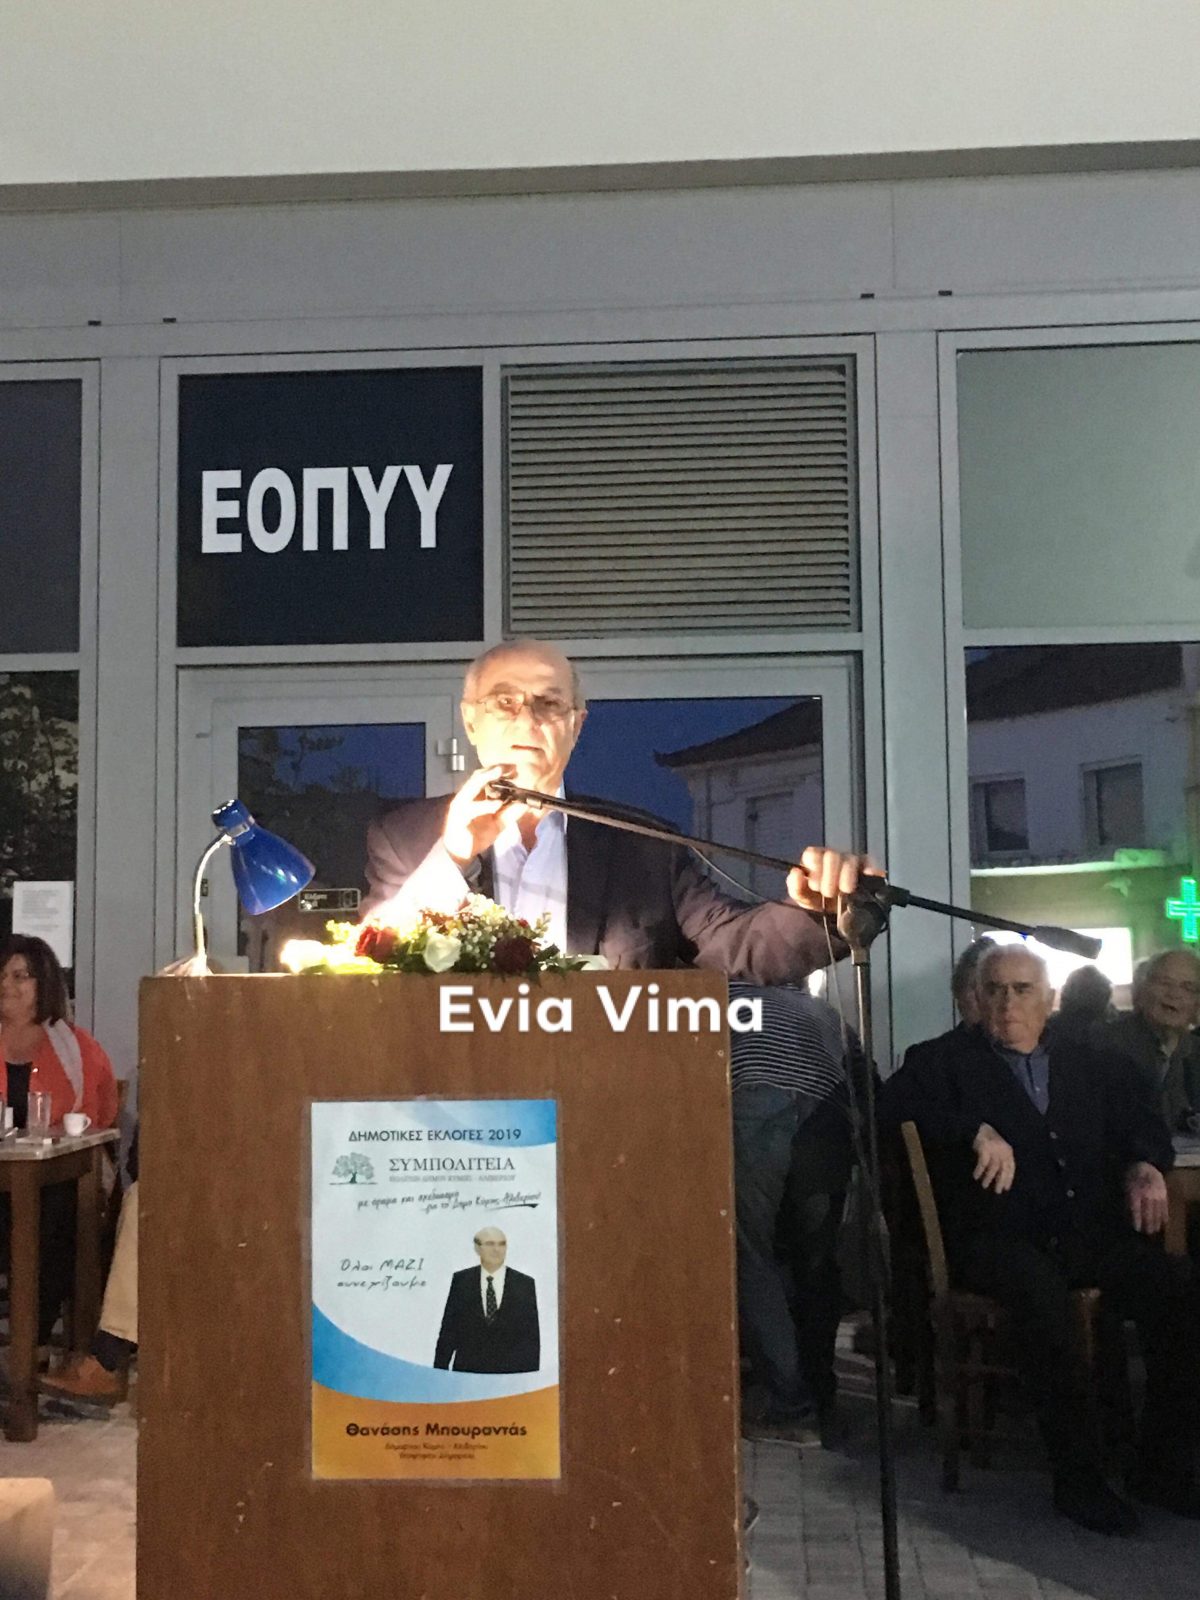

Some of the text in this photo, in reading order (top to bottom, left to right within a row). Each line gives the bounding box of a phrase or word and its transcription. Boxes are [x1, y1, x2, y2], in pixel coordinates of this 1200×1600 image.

[202, 464, 453, 553] ΕΟΠΥΥ
[349, 1128, 522, 1142] ΔΗΜΟΤΙΚΕΣ ΕΚΛΟΓΕΣ 2019
[389, 1157, 515, 1171] ΣΥΜΠΟΛΙΤΕΙΑ
